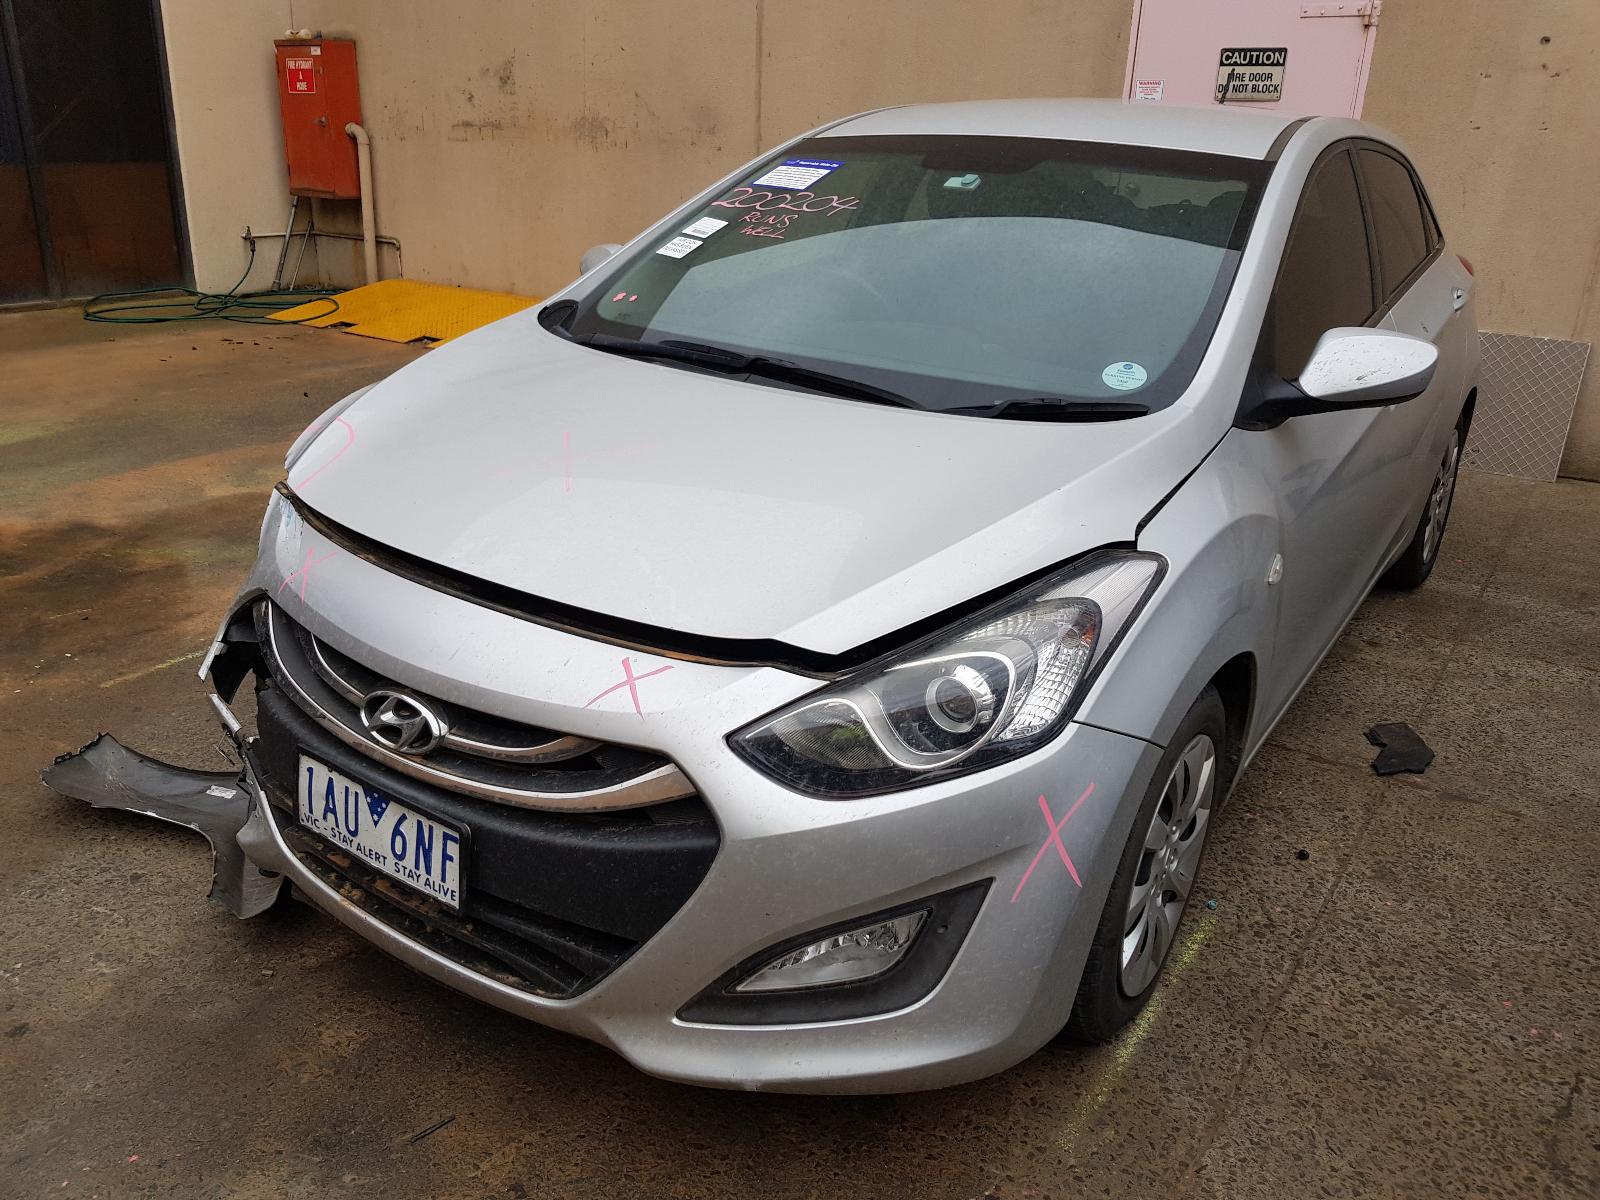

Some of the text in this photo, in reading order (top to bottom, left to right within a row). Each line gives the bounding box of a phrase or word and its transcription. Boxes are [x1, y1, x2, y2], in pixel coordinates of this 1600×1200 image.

[1222, 51, 1285, 64] CAUTION
[1248, 72, 1273, 82] DOOR
[1231, 84, 1249, 93] NOT
[1250, 83, 1280, 94] BLOCK
[712, 187, 860, 217] 200204
[739, 211, 799, 228] RUNS
[740, 225, 785, 239] WELL
[306, 767, 459, 884] 1AU 6NF
[303, 812, 319, 828] VIC
[331, 827, 353, 848] STAY
[356, 843, 388, 867] ALERT
[394, 862, 421, 884] STAY
[424, 878, 457, 902] ALIVE
